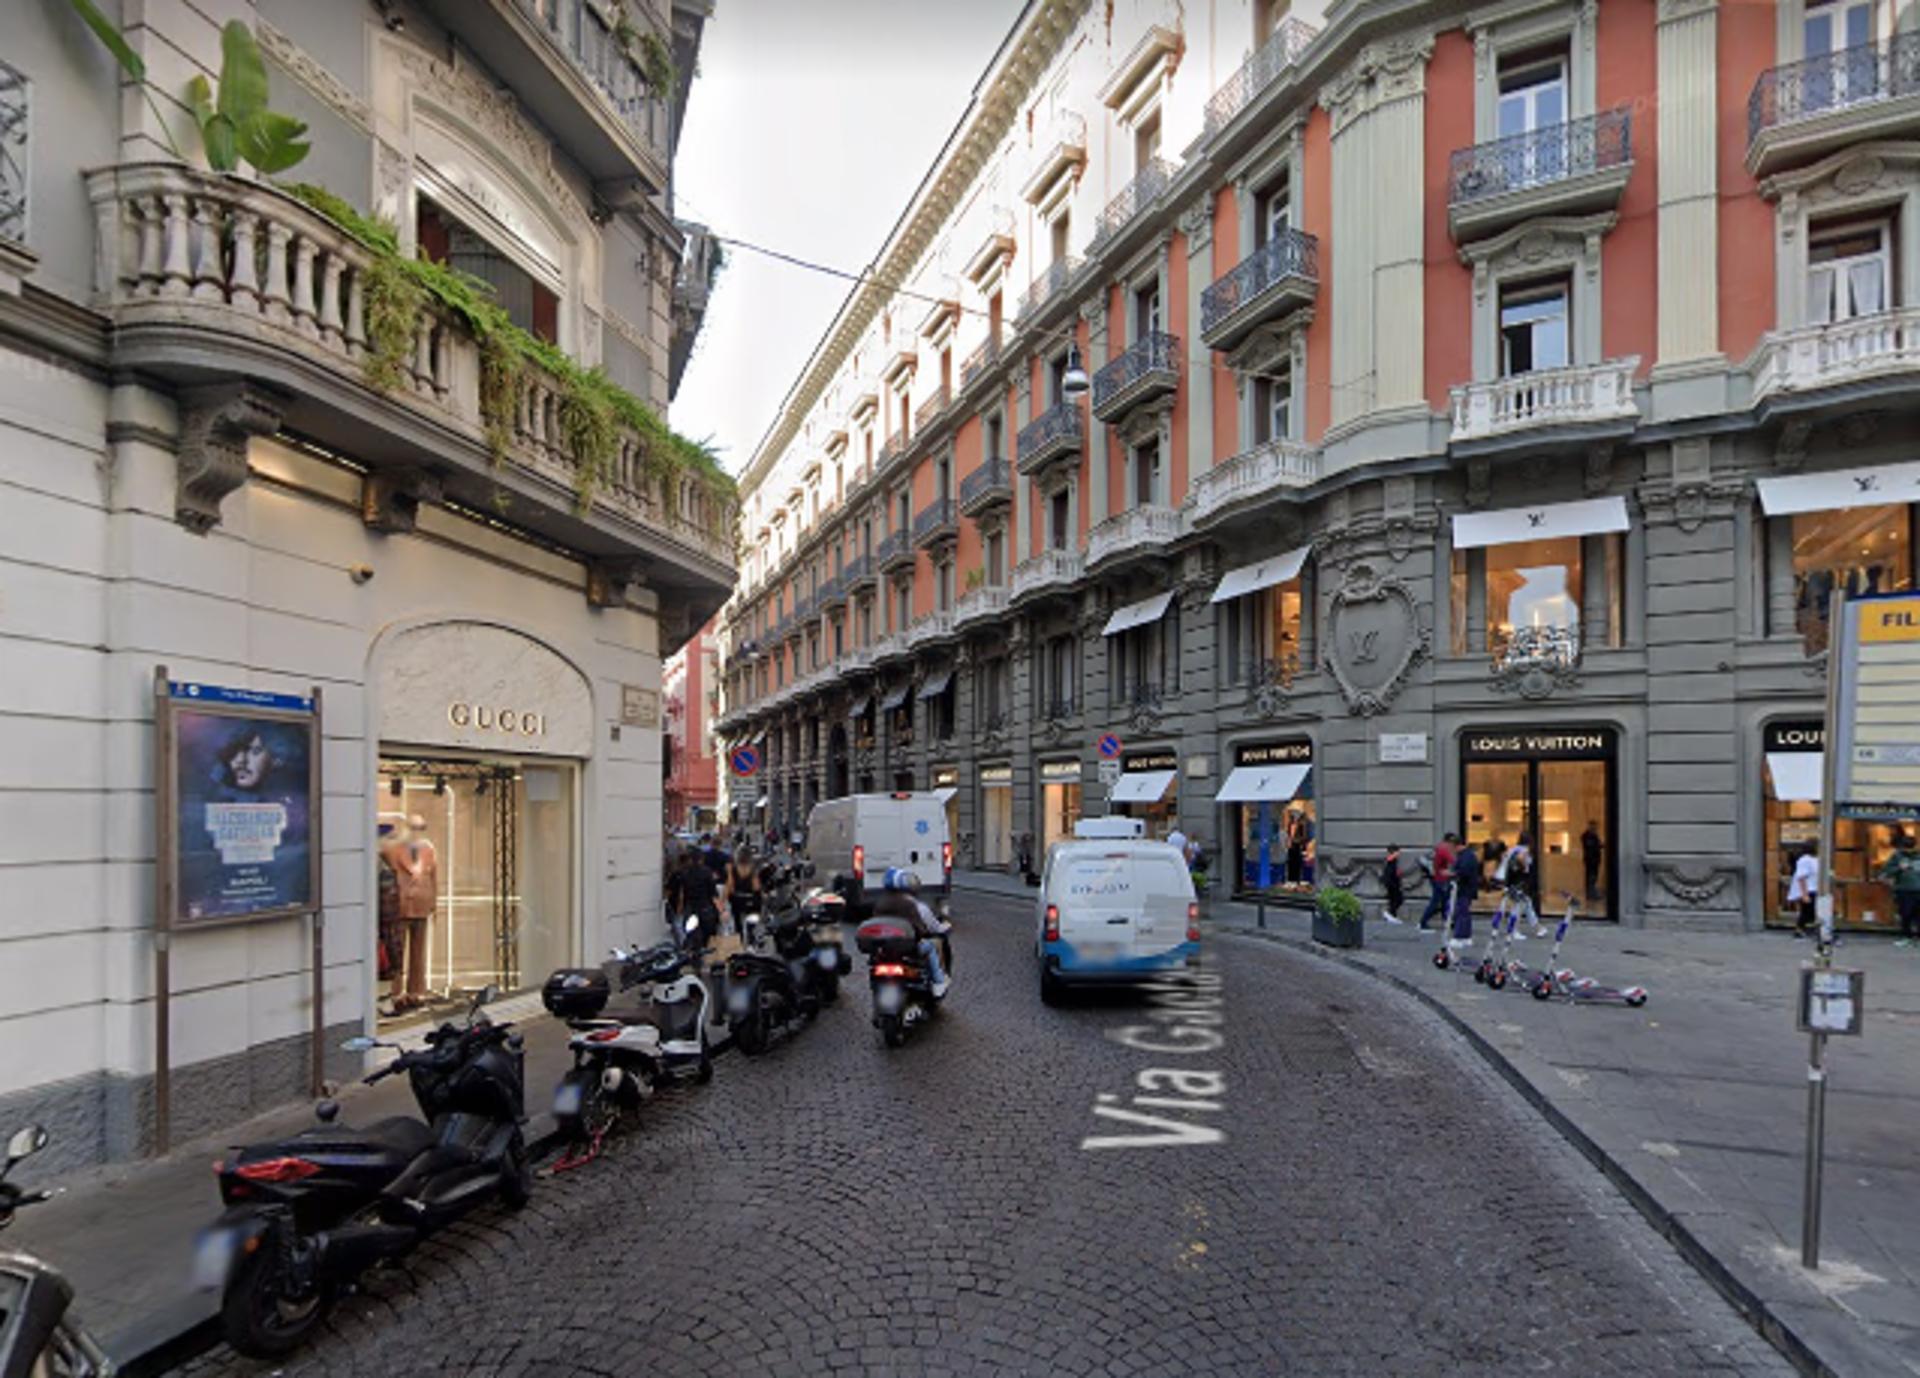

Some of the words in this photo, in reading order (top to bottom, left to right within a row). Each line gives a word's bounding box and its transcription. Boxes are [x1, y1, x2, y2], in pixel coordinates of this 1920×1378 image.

[447, 702, 546, 737] GUCCI
[1471, 737, 1521, 751] LOUIS
[1525, 735, 1603, 750] VUITTON
